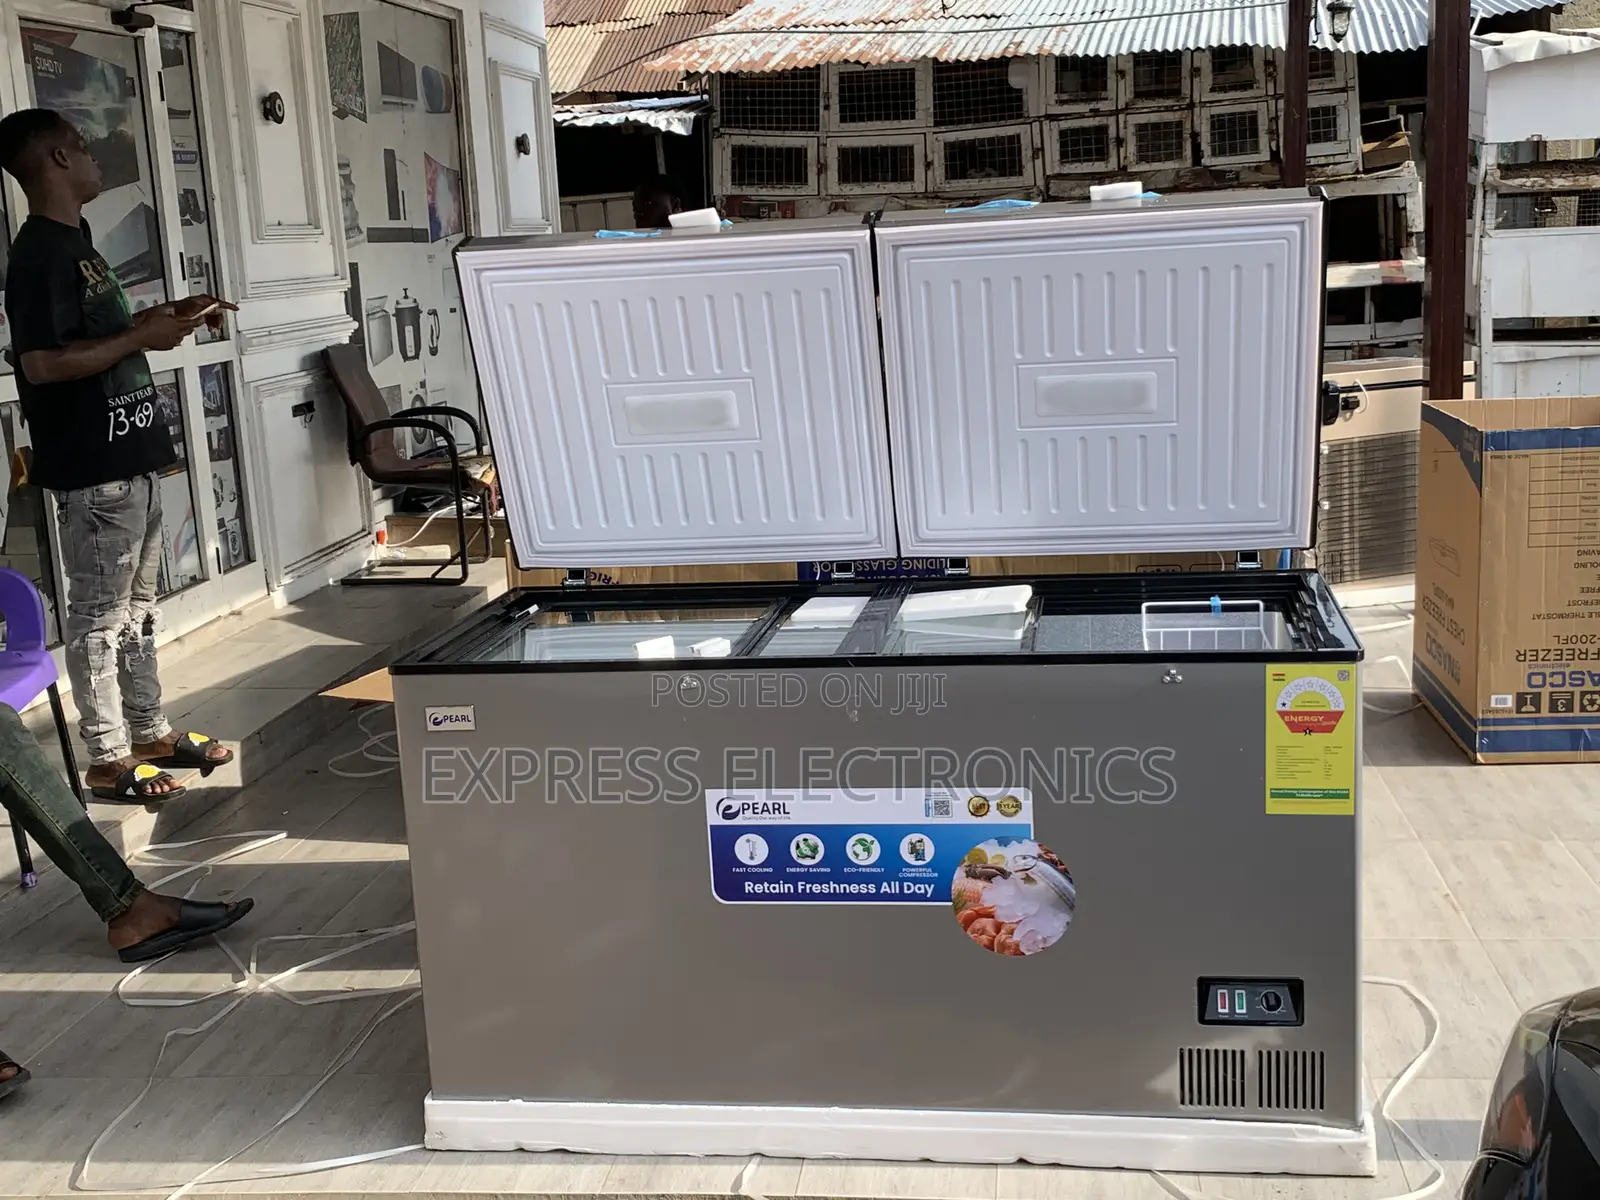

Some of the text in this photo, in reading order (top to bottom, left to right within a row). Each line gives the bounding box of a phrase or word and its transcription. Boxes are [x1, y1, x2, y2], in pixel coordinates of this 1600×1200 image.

[856, 560, 897, 572] GLASS
[902, 558, 946, 571] LIDING
[1573, 561, 1600, 569] OLING
[1531, 611, 1585, 620] THERMOSTAT
[1516, 647, 1600, 662] FREEZER
[1528, 662, 1570, 670] electronics
[1284, 715, 1324, 724] ENERGY
[741, 802, 790, 815] PEARL
[744, 880, 935, 898] Retain Freshness All Day
